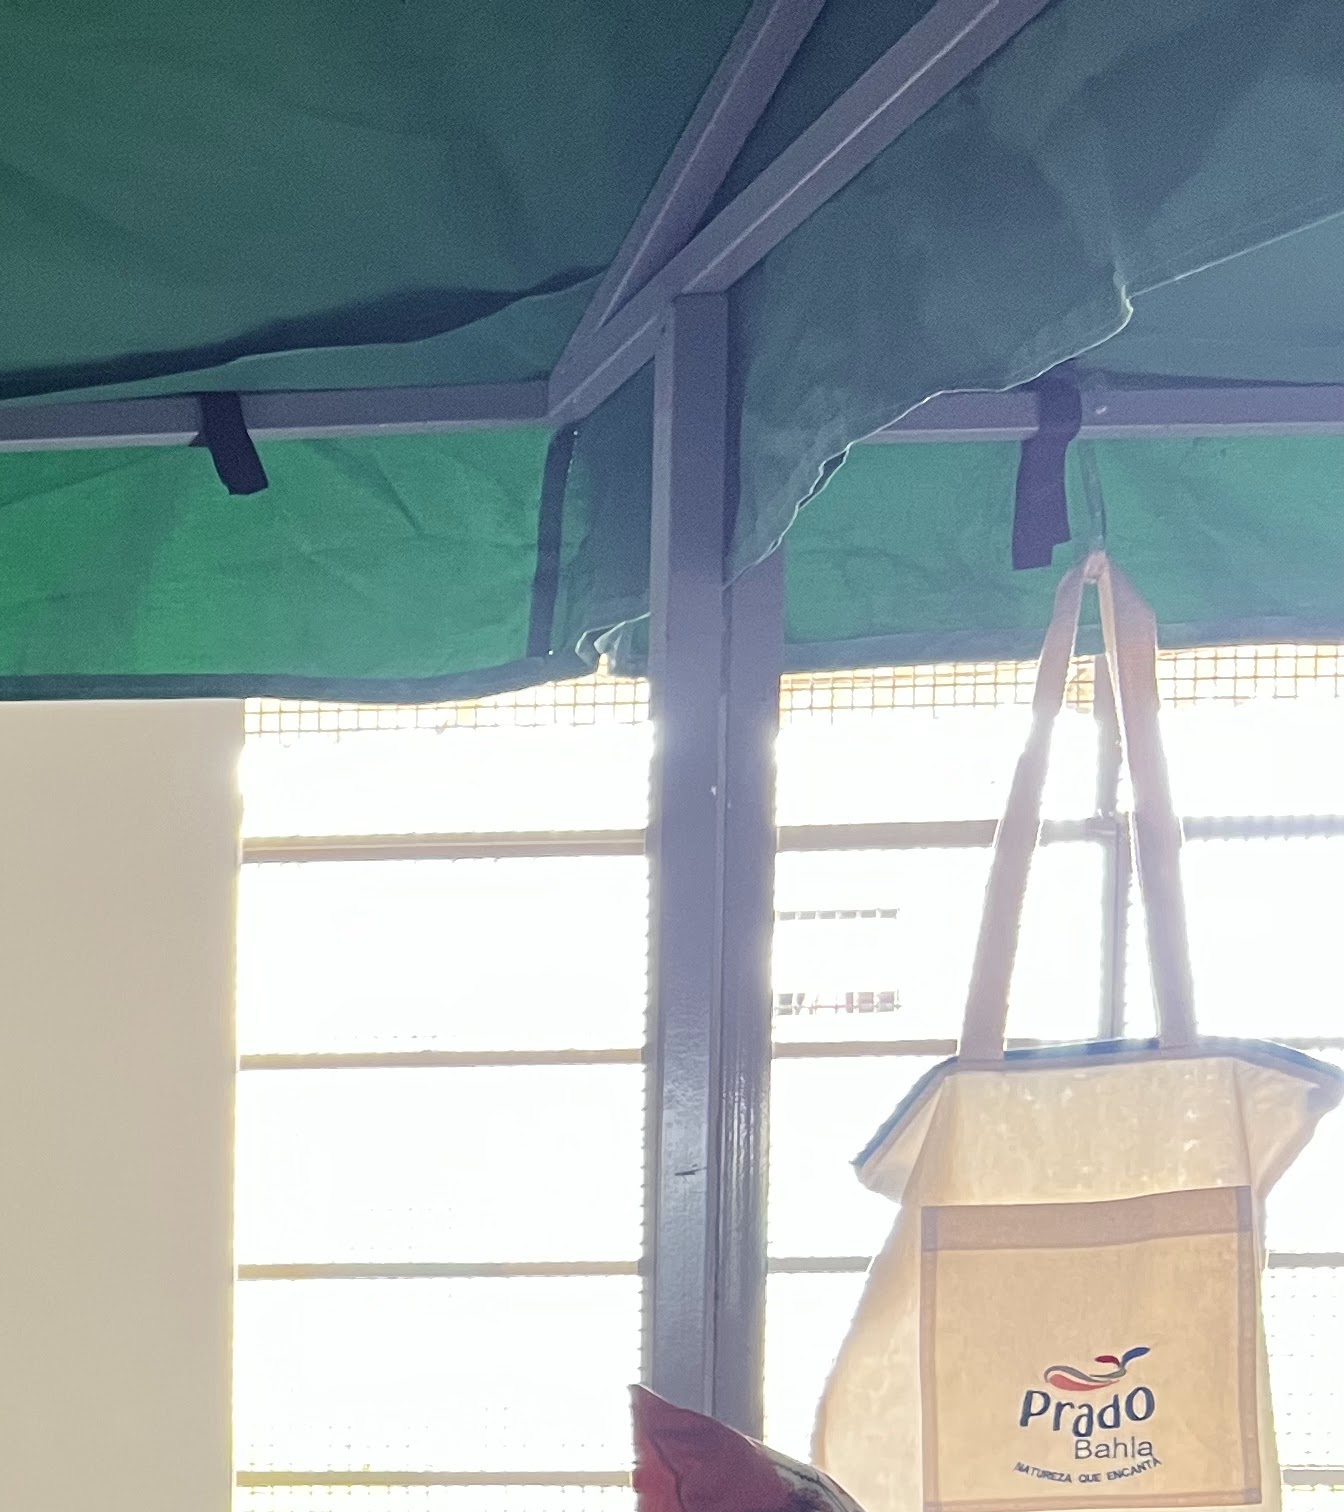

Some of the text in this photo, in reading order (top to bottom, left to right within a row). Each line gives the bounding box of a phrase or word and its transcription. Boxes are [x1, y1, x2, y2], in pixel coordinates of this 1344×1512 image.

[1019, 1386, 1155, 1437] Prado
[1074, 1436, 1154, 1459] Bahia
[1014, 1456, 1162, 1483] NATUREZA QUE ENCANTA
